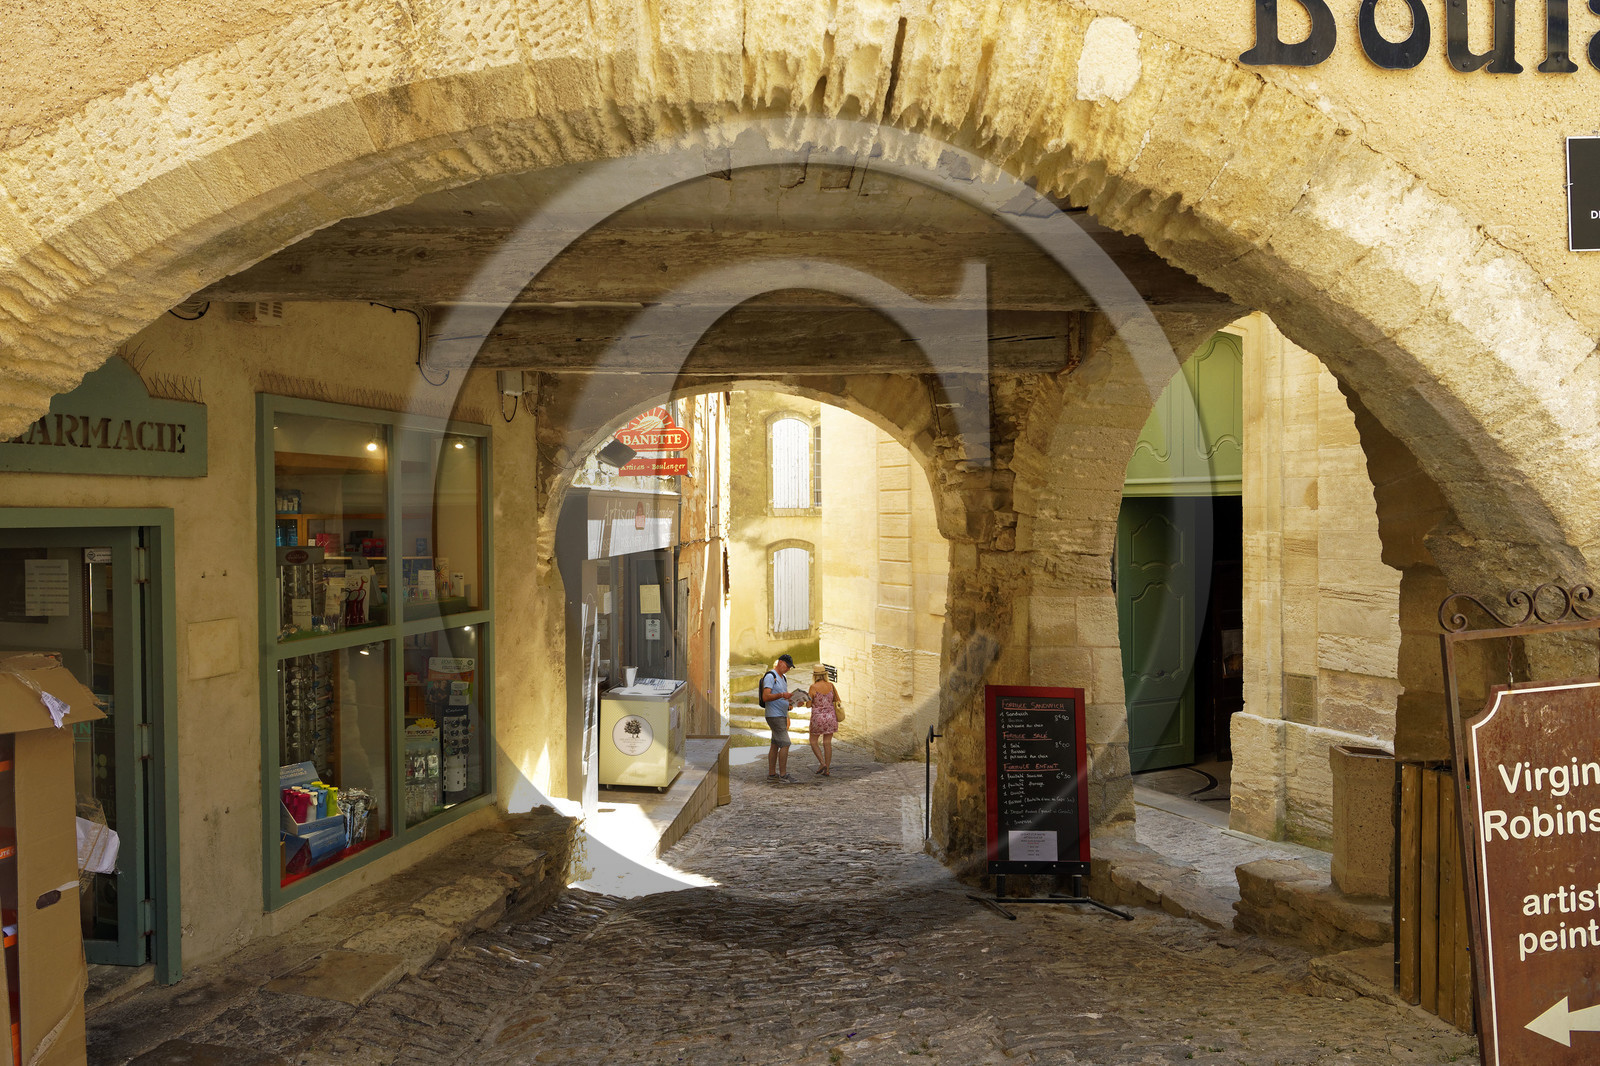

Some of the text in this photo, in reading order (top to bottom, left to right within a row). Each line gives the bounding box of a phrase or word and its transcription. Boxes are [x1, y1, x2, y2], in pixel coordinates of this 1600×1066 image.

[622, 434, 682, 445] BANETTE
[652, 462, 686, 472] Boulanger
[1498, 756, 1600, 796] Virgin
[1519, 919, 1600, 961] peint
